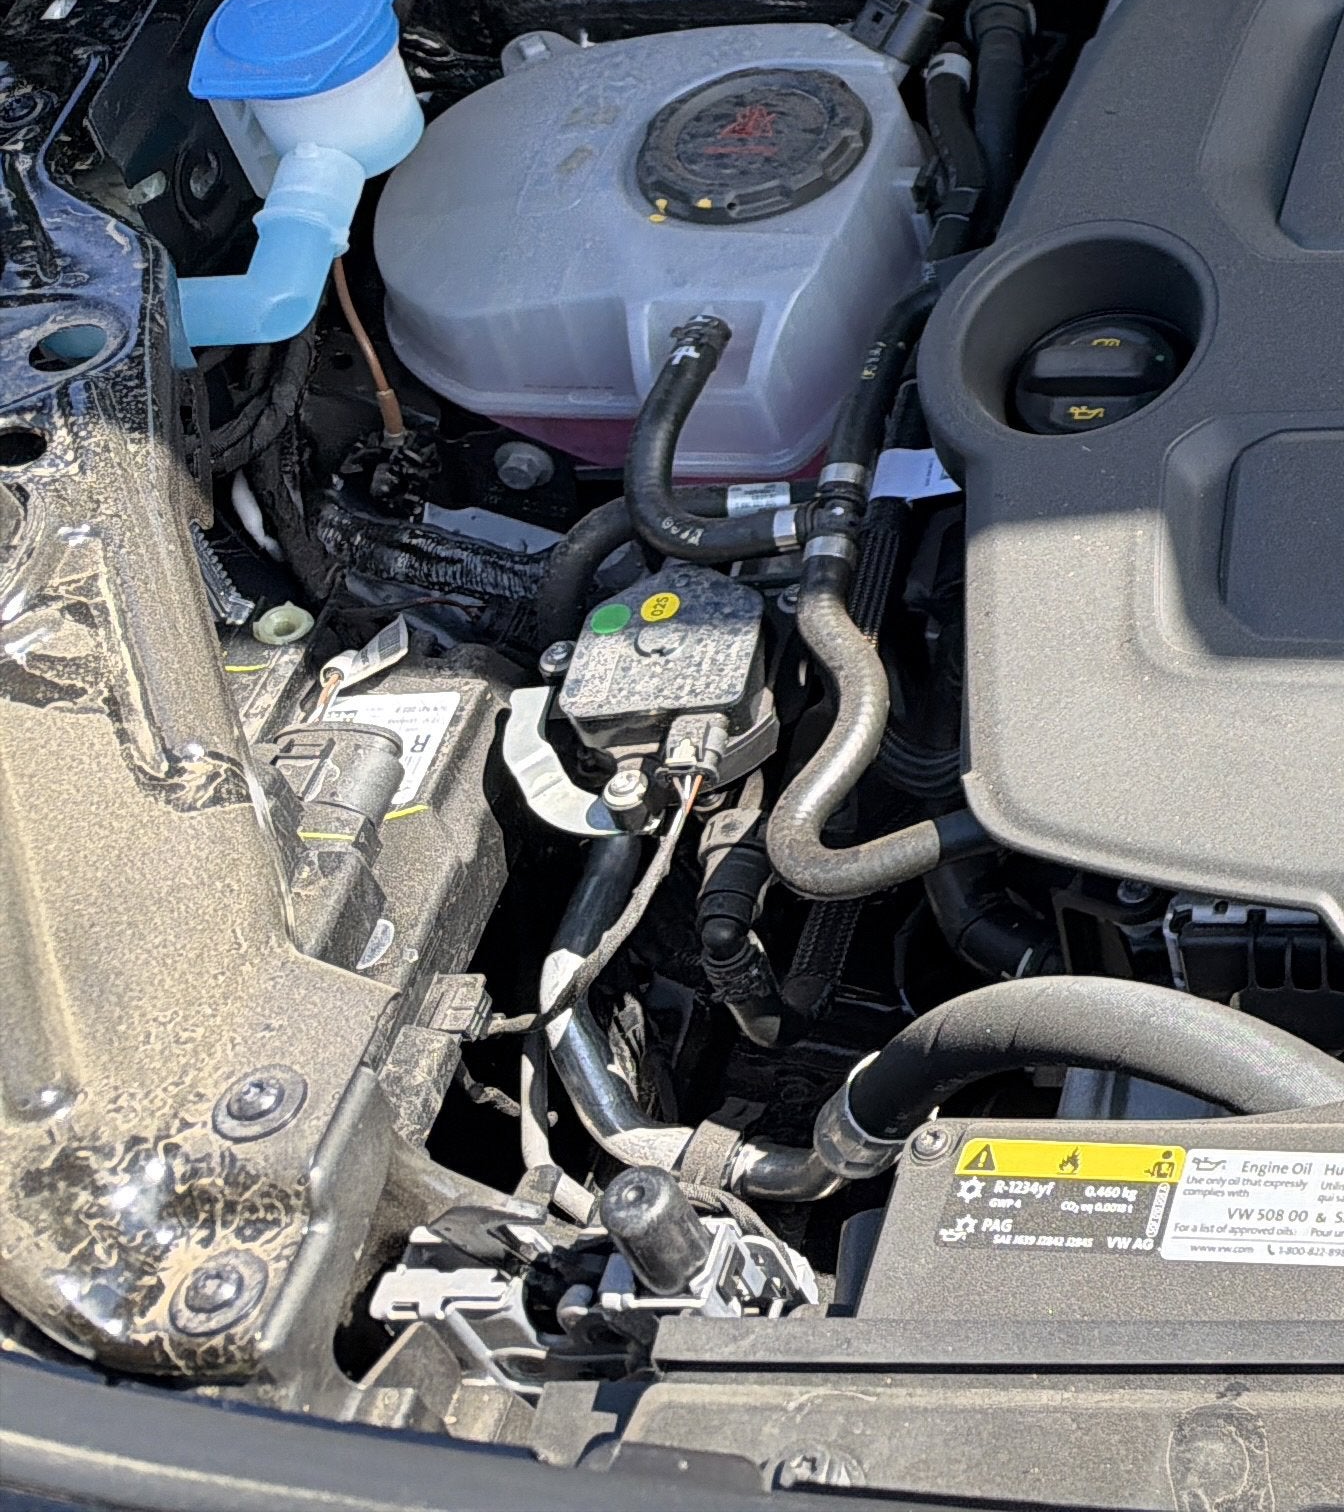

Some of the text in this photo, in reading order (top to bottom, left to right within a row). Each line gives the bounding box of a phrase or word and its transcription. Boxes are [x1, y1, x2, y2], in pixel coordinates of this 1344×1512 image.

[1242, 1161, 1314, 1177] Engine Oil
[1227, 1207, 1255, 1221] VW
[1257, 1208, 1284, 1222] 508
[1288, 1209, 1309, 1223] 00
[1316, 1212, 1327, 1224] &
[981, 1217, 1014, 1233] PAG
[1106, 1236, 1155, 1251] VW AG
